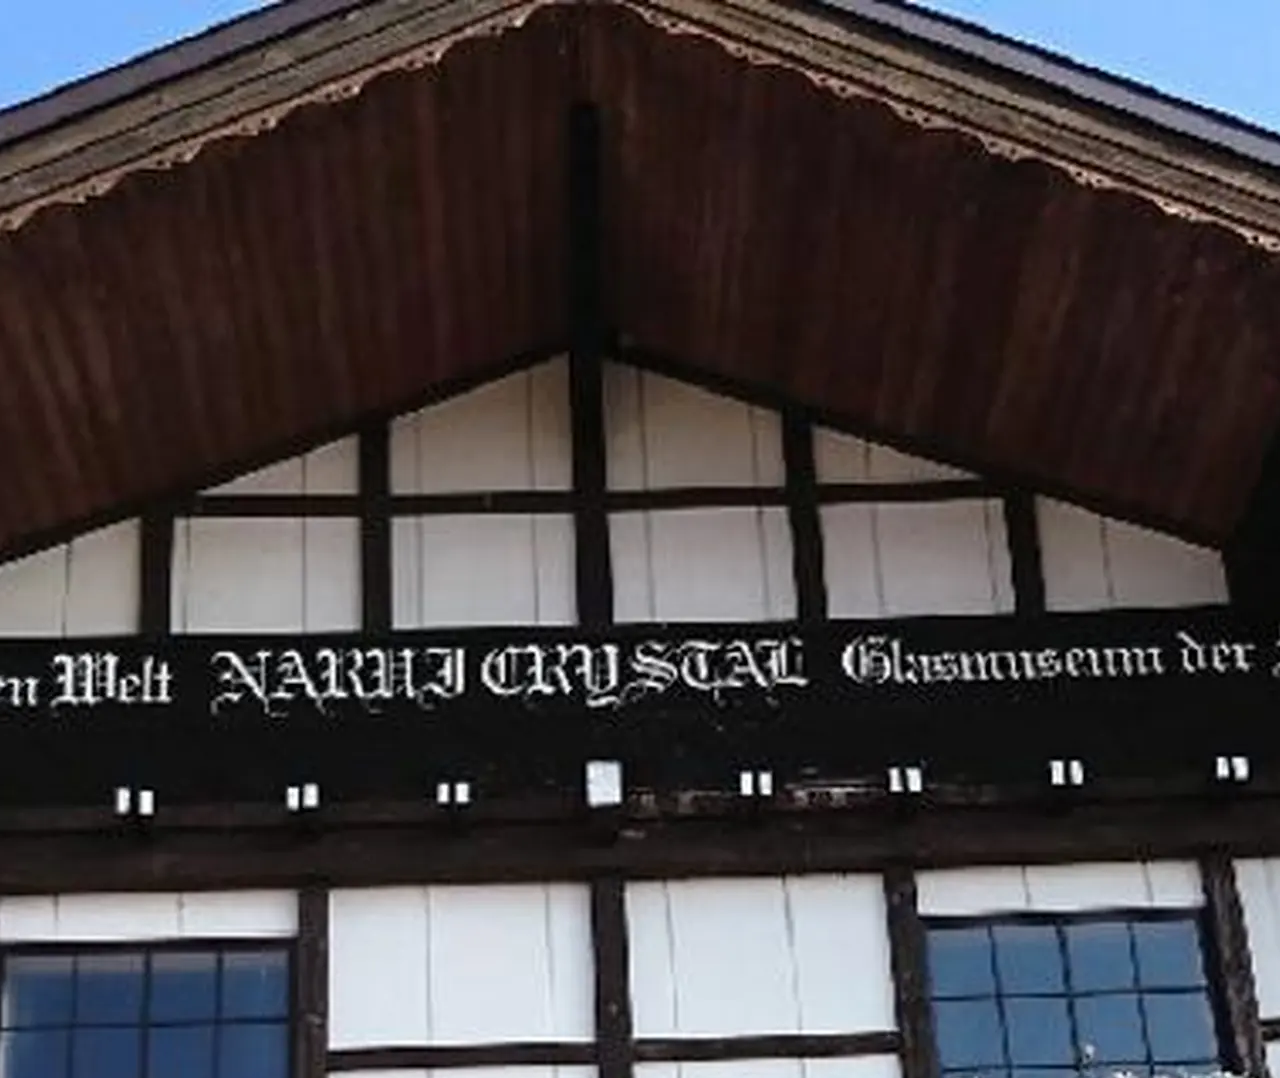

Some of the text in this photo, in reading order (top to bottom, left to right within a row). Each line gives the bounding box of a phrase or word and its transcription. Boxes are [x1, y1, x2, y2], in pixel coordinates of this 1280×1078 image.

[50, 650, 173, 708] Welt
[480, 636, 811, 709] CRYSTAL
[841, 633, 1167, 686] Glasmuseum
[1176, 629, 1257, 674] der
